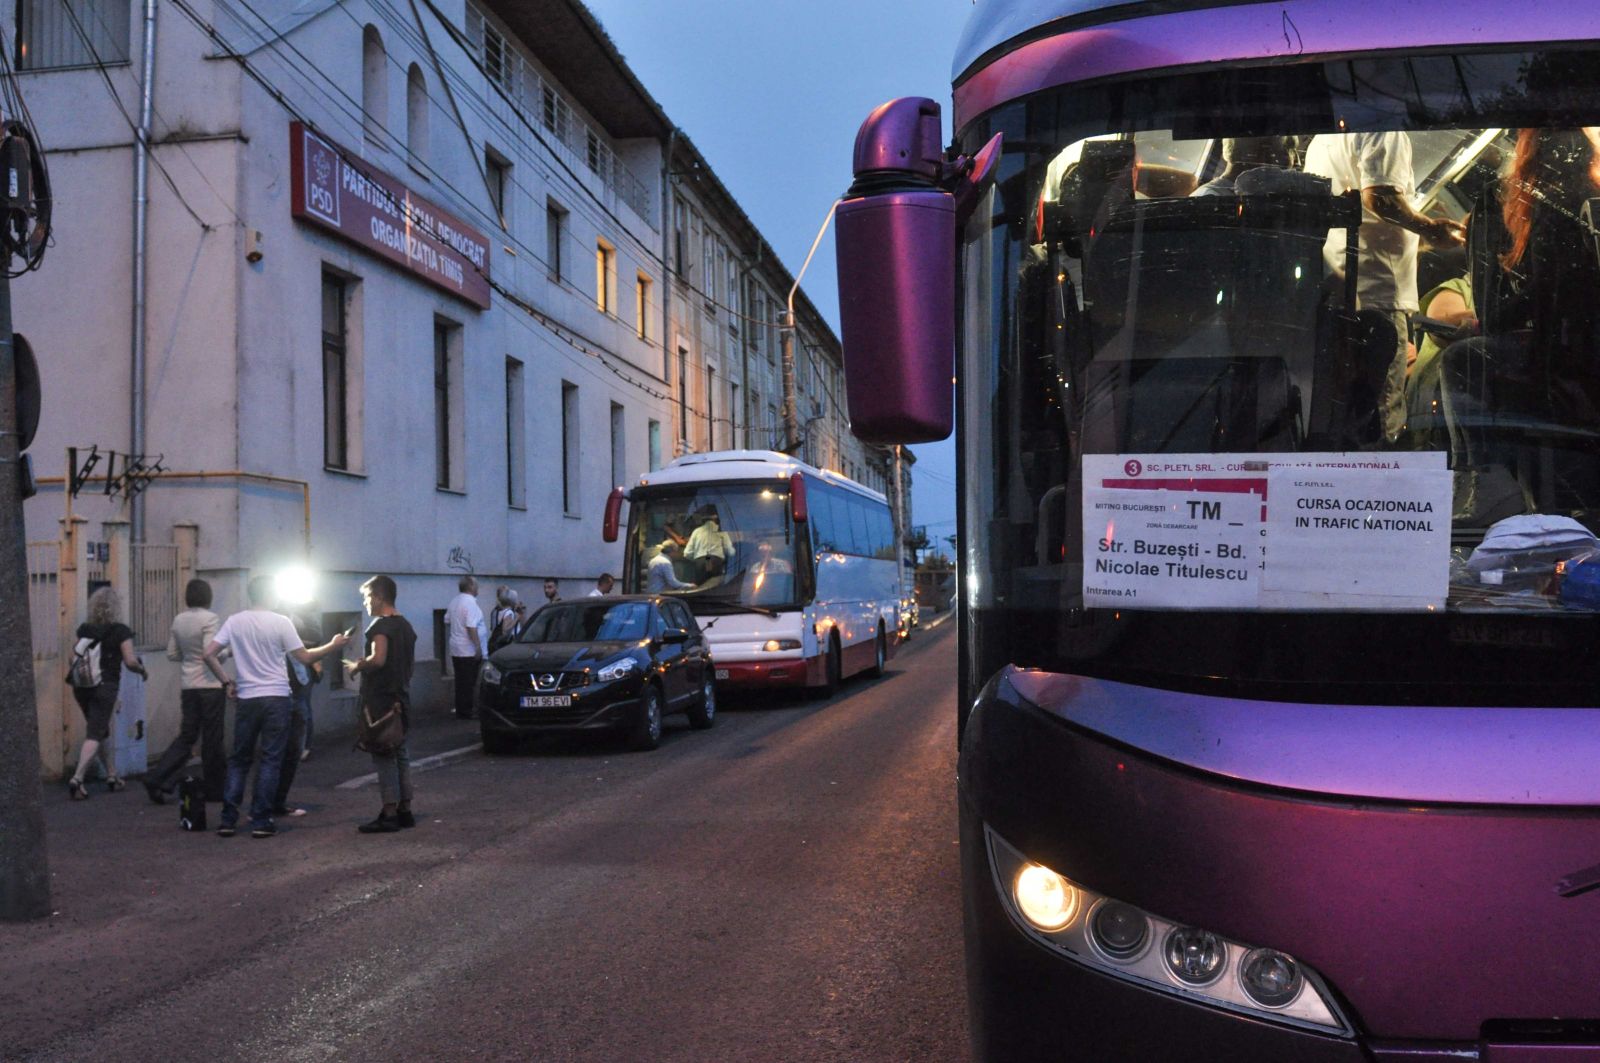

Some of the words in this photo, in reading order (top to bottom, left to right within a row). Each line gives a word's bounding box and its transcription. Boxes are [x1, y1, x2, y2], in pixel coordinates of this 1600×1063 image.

[311, 183, 333, 214] PSD
[343, 164, 397, 217] PARTIDUL
[438, 221, 485, 268] DEMOCRAT
[1147, 464, 1162, 472] SC.
[1164, 464, 1193, 472] PLETL
[1186, 501, 1221, 520] TM
[1297, 498, 1341, 510] CURSA
[1345, 499, 1433, 513] OCAZIONALA
[1295, 516, 1310, 528] IN
[1313, 517, 1360, 529] TRAFIC
[1363, 518, 1434, 532] NATIONAL
[1098, 538, 1127, 553] Str.
[1134, 540, 1199, 560] Buzești
[1217, 543, 1247, 559] Bd.
[1095, 558, 1160, 576] Nicolae
[1165, 562, 1248, 581] Titulescu
[1086, 586, 1123, 596] Intrarea
[1124, 588, 1137, 597] A1
